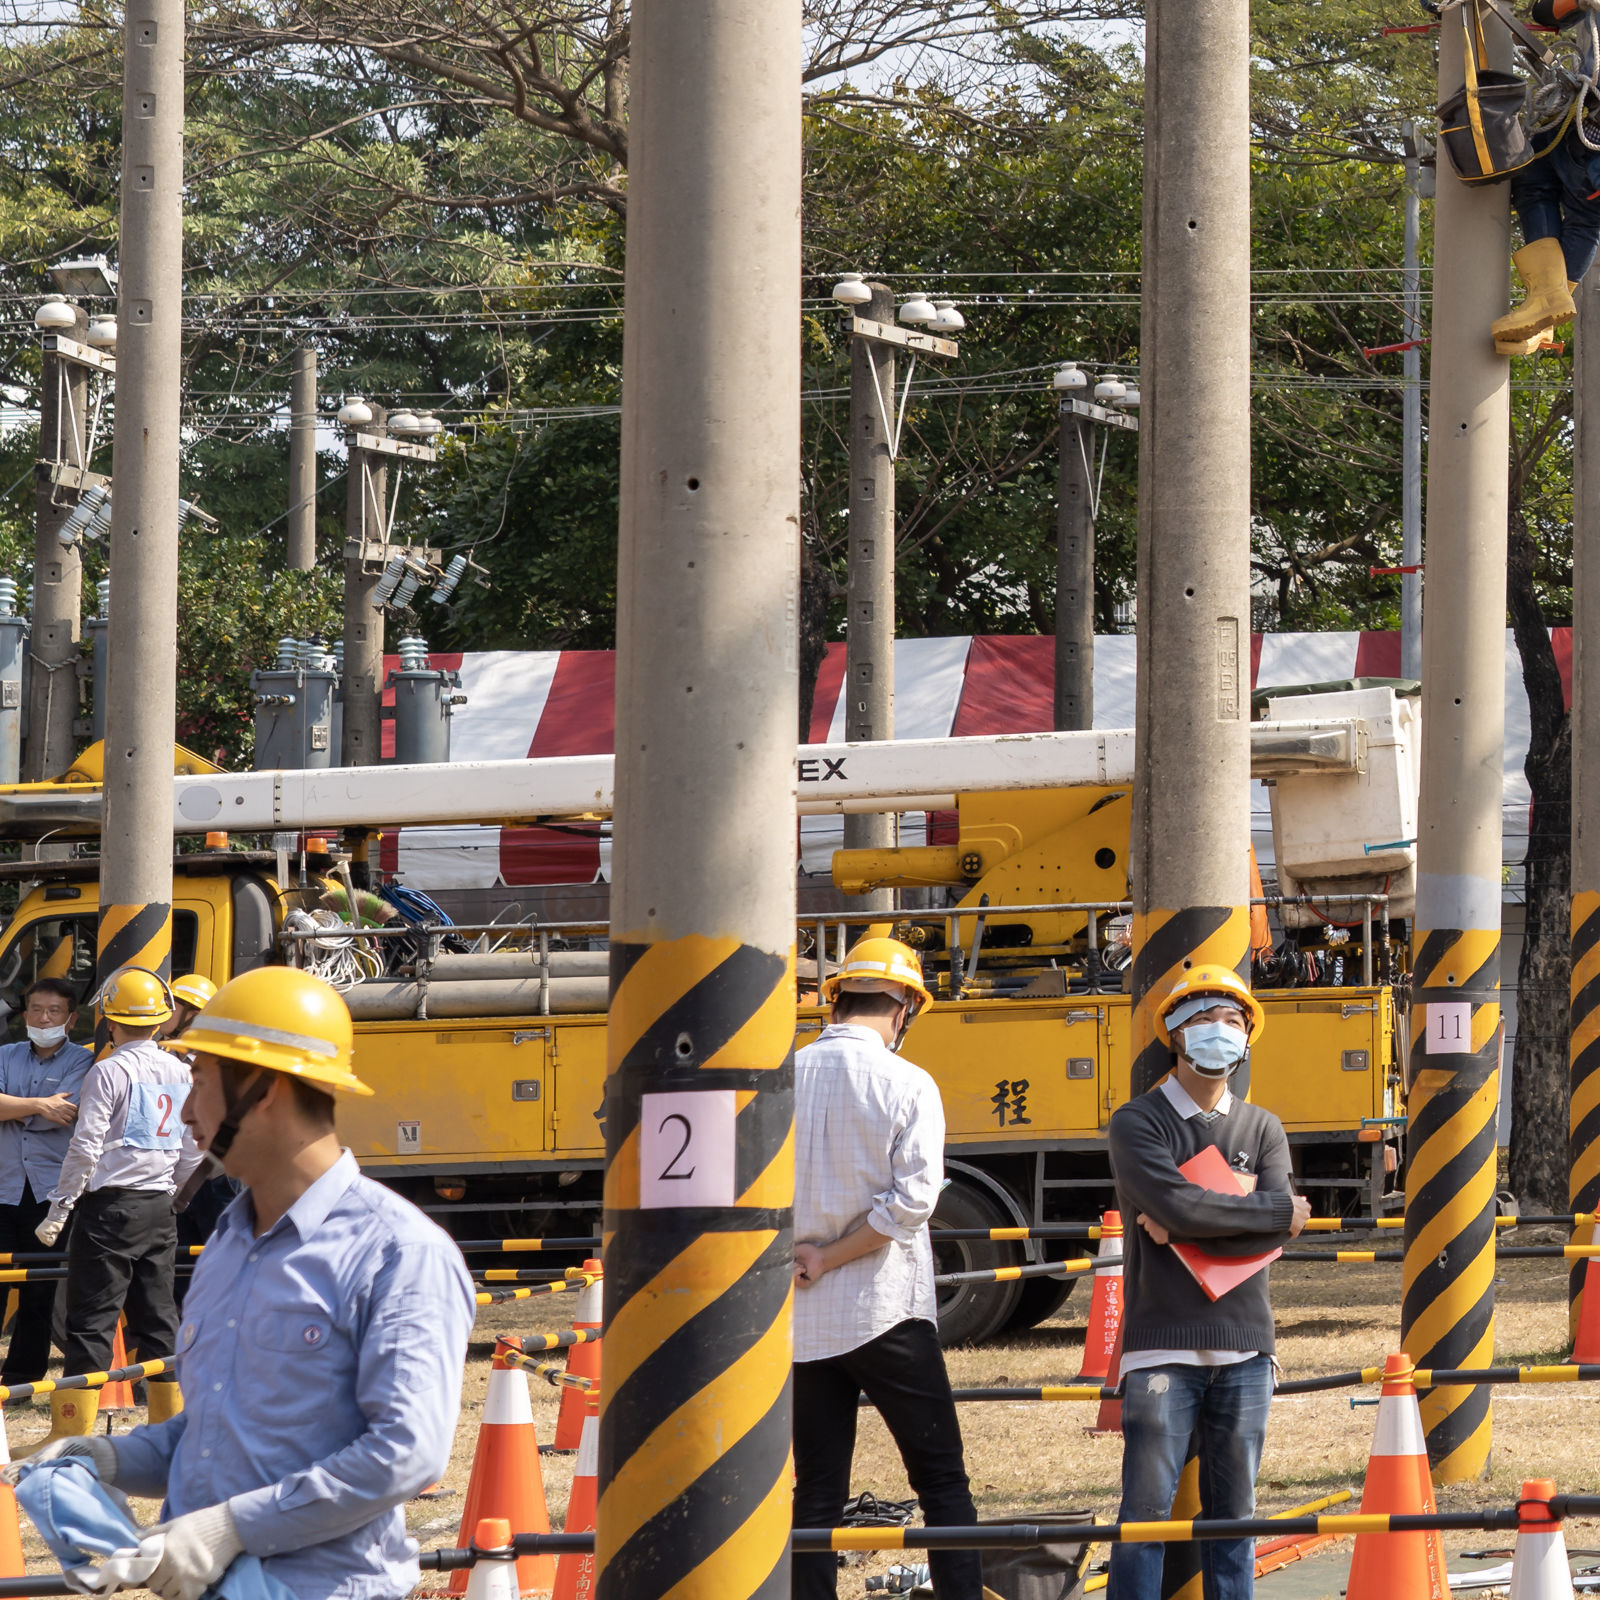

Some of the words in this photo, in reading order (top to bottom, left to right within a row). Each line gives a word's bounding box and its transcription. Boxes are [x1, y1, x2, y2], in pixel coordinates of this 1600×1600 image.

[1438, 1014, 1462, 1040] 11
[156, 1093, 172, 1137] 2
[990, 1078, 1032, 1128] 程
[658, 1113, 697, 1181] 2
